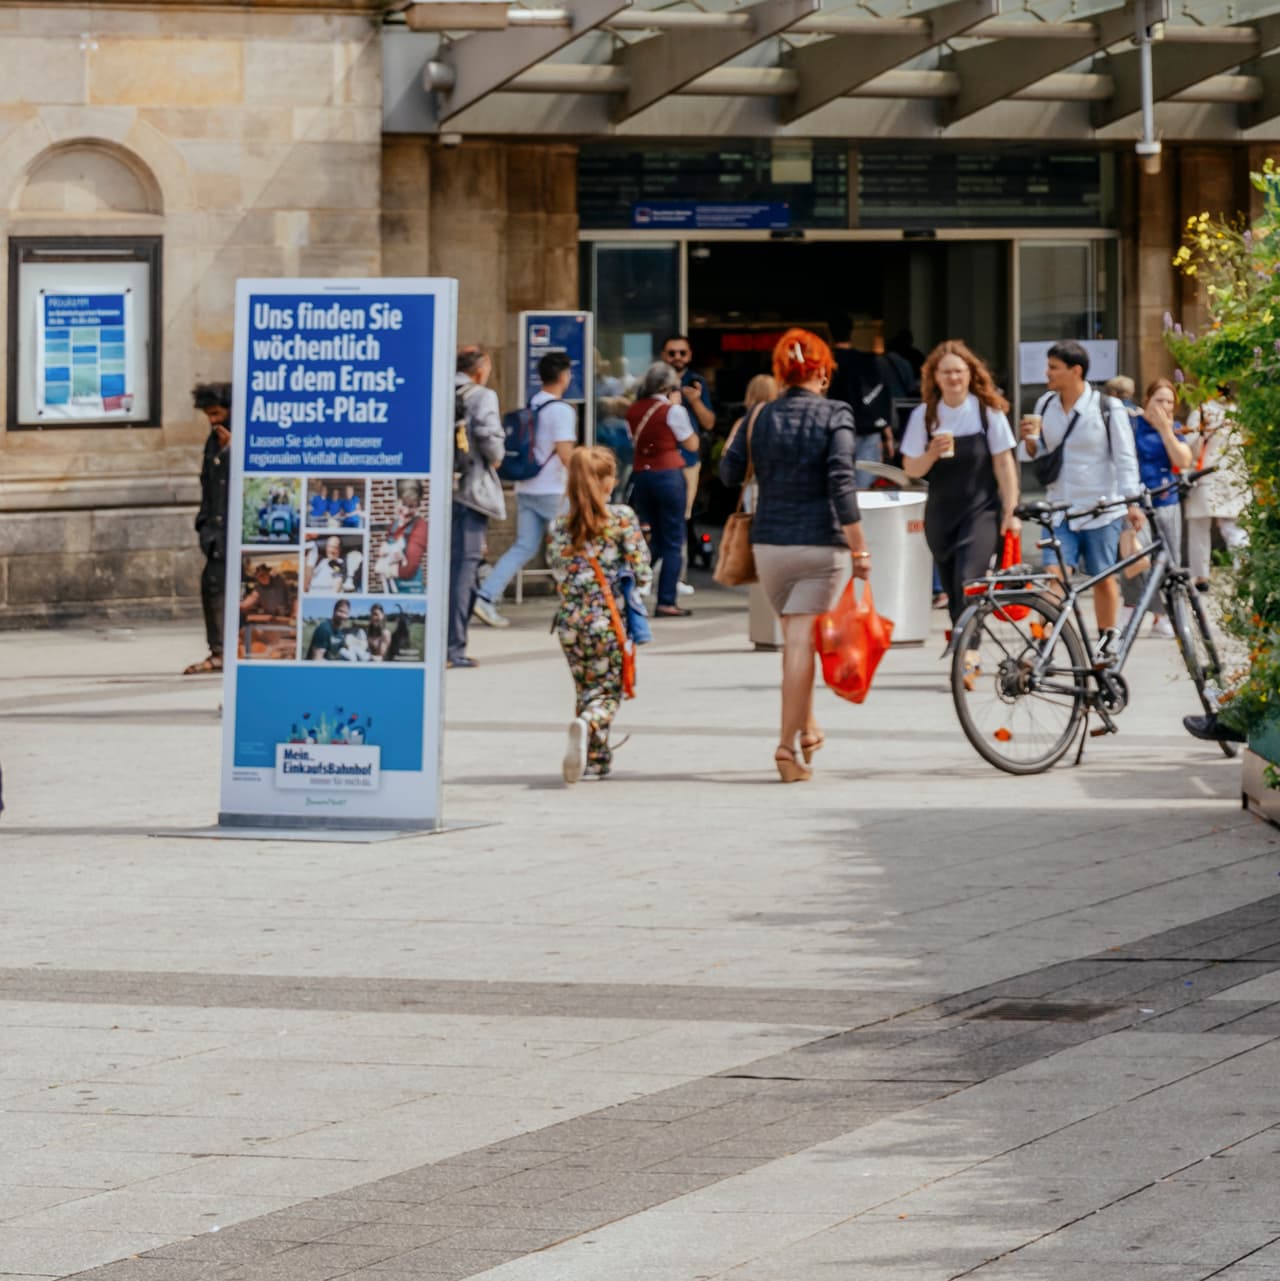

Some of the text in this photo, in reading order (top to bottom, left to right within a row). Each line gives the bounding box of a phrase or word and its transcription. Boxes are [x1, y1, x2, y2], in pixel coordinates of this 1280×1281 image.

[254, 302, 403, 330] Uns finden Sie
[253, 333, 380, 361] wöchentlich
[252, 364, 405, 392] auf dem Ernst-
[250, 395, 388, 429] August-Platz
[250, 434, 285, 448] Lassen
[286, 434, 302, 448] Sie
[303, 434, 323, 448] sich
[324, 437, 343, 448] von
